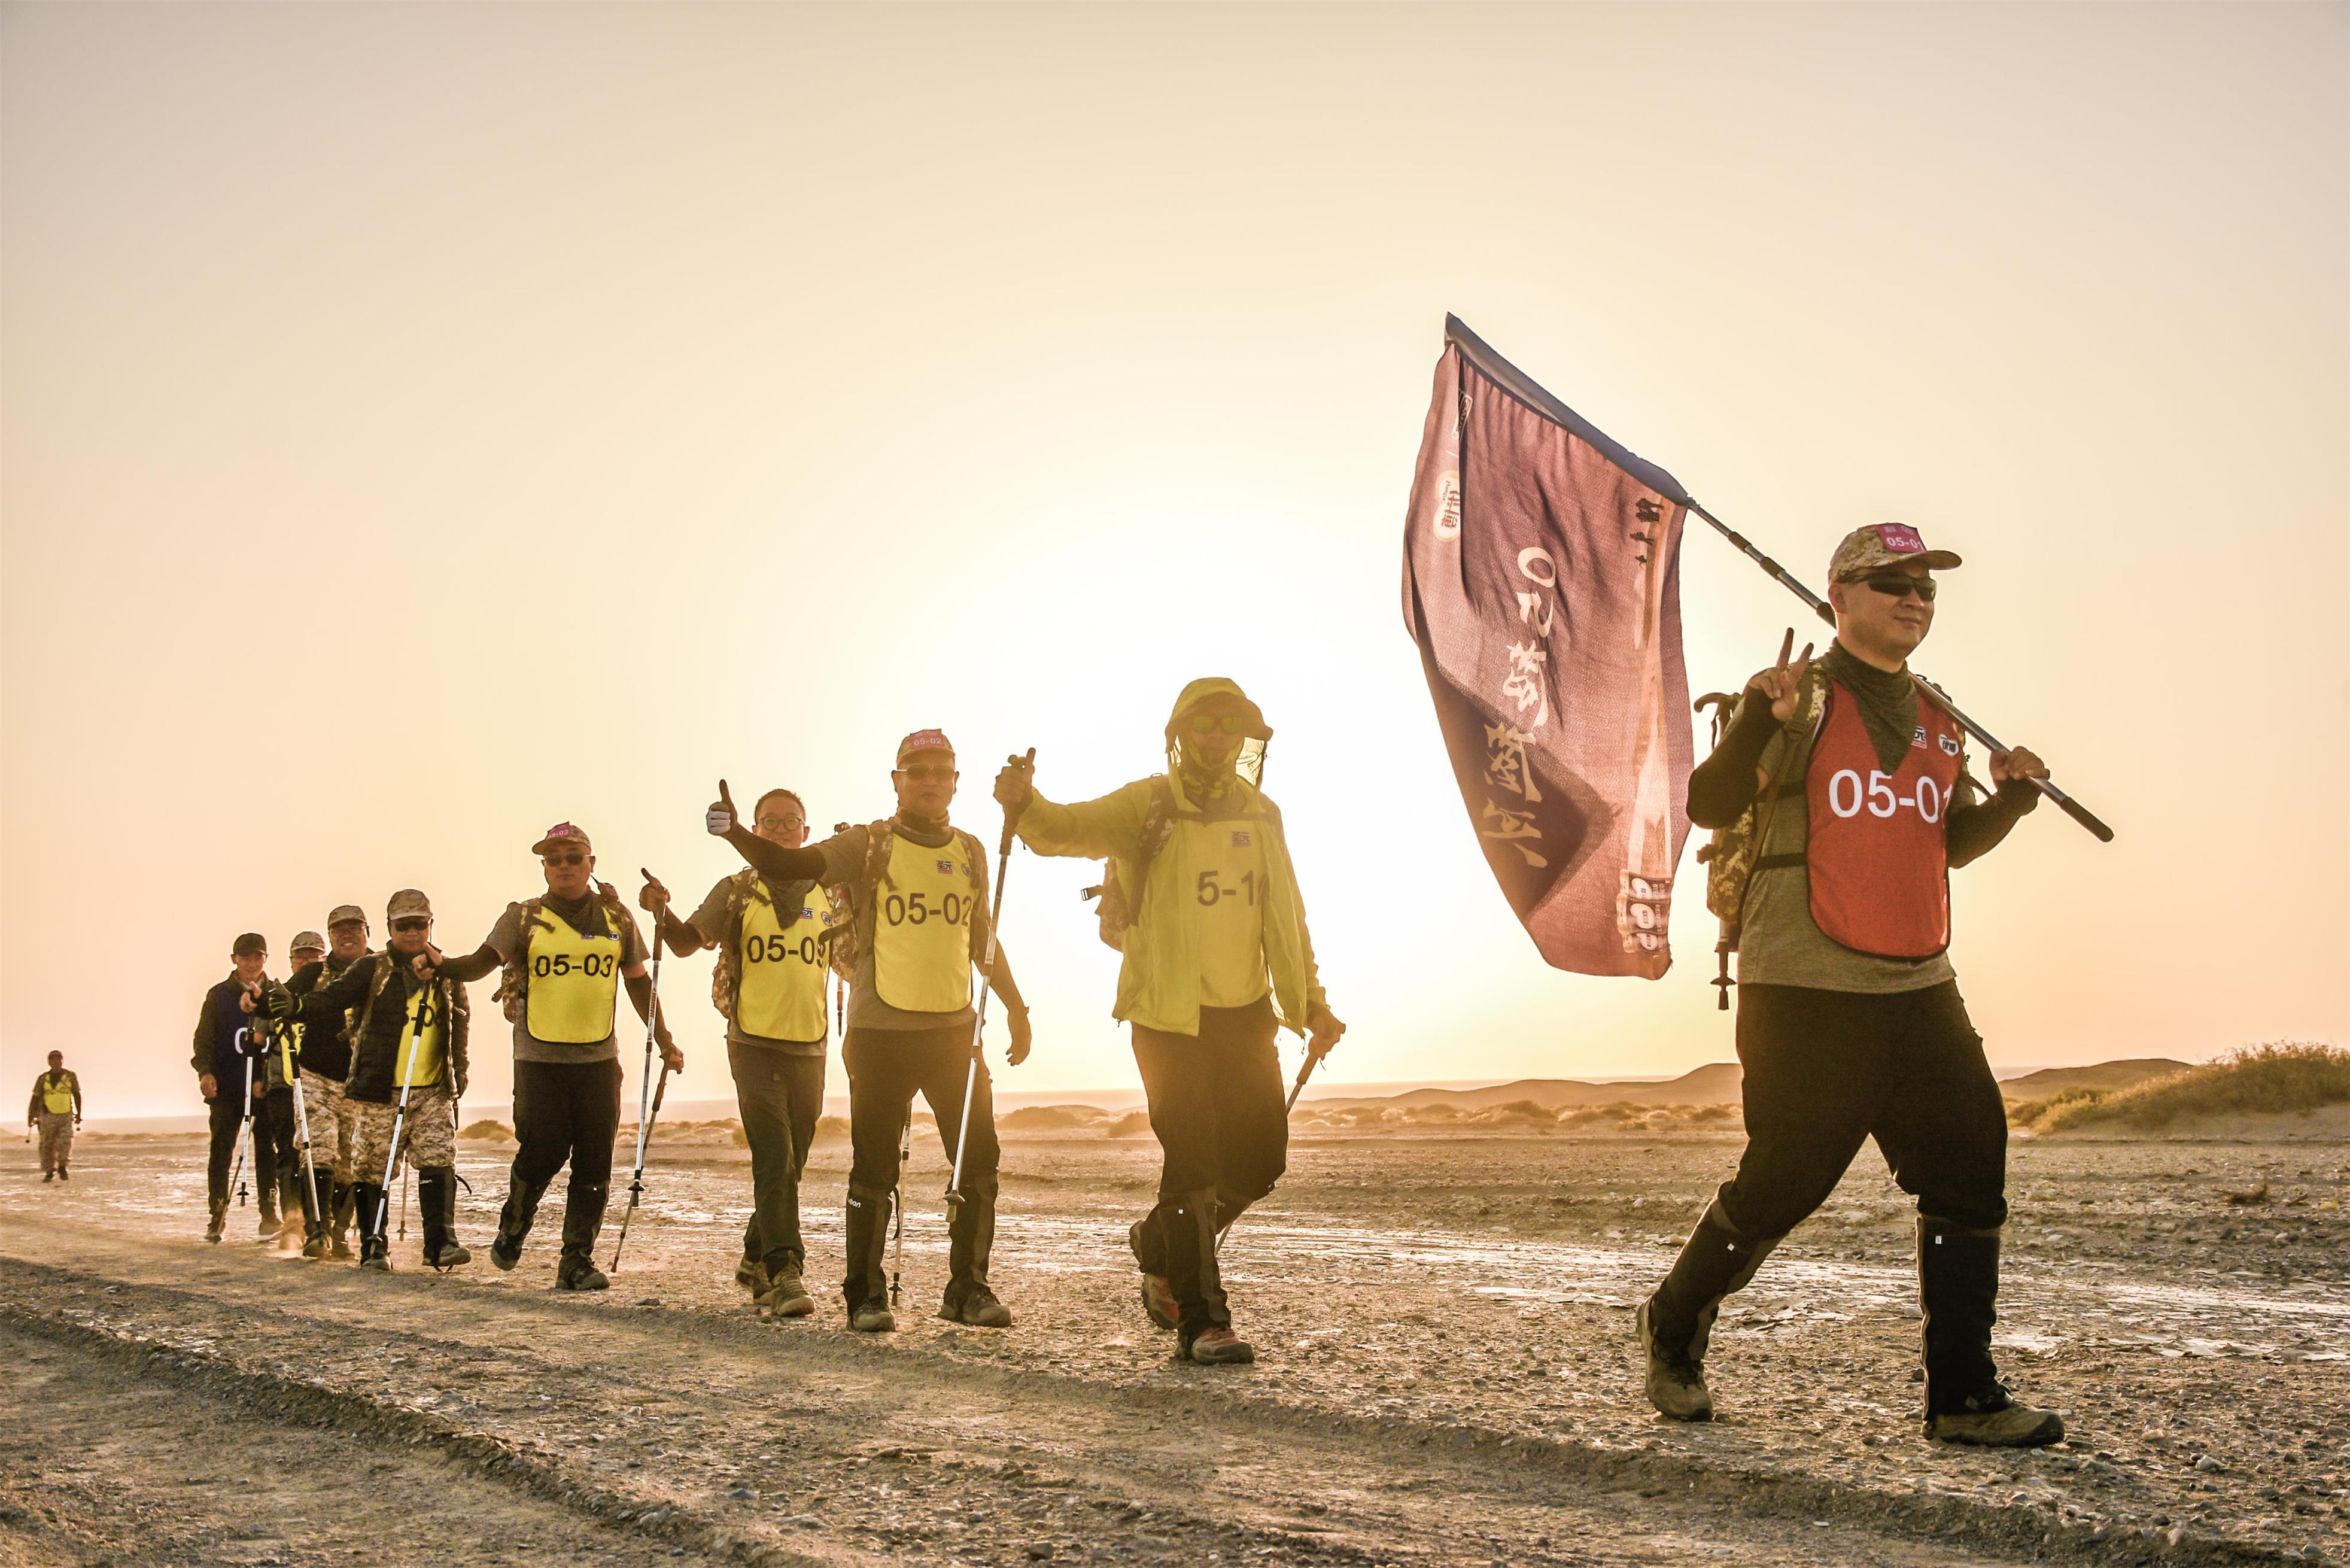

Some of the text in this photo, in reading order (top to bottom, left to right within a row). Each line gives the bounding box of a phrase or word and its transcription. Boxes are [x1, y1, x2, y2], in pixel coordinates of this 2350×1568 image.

[1886, 536, 1925, 551] 05-01
[914, 737, 943, 746] 05-02
[885, 892, 972, 927] 05-02
[534, 953, 614, 978] 05-03
